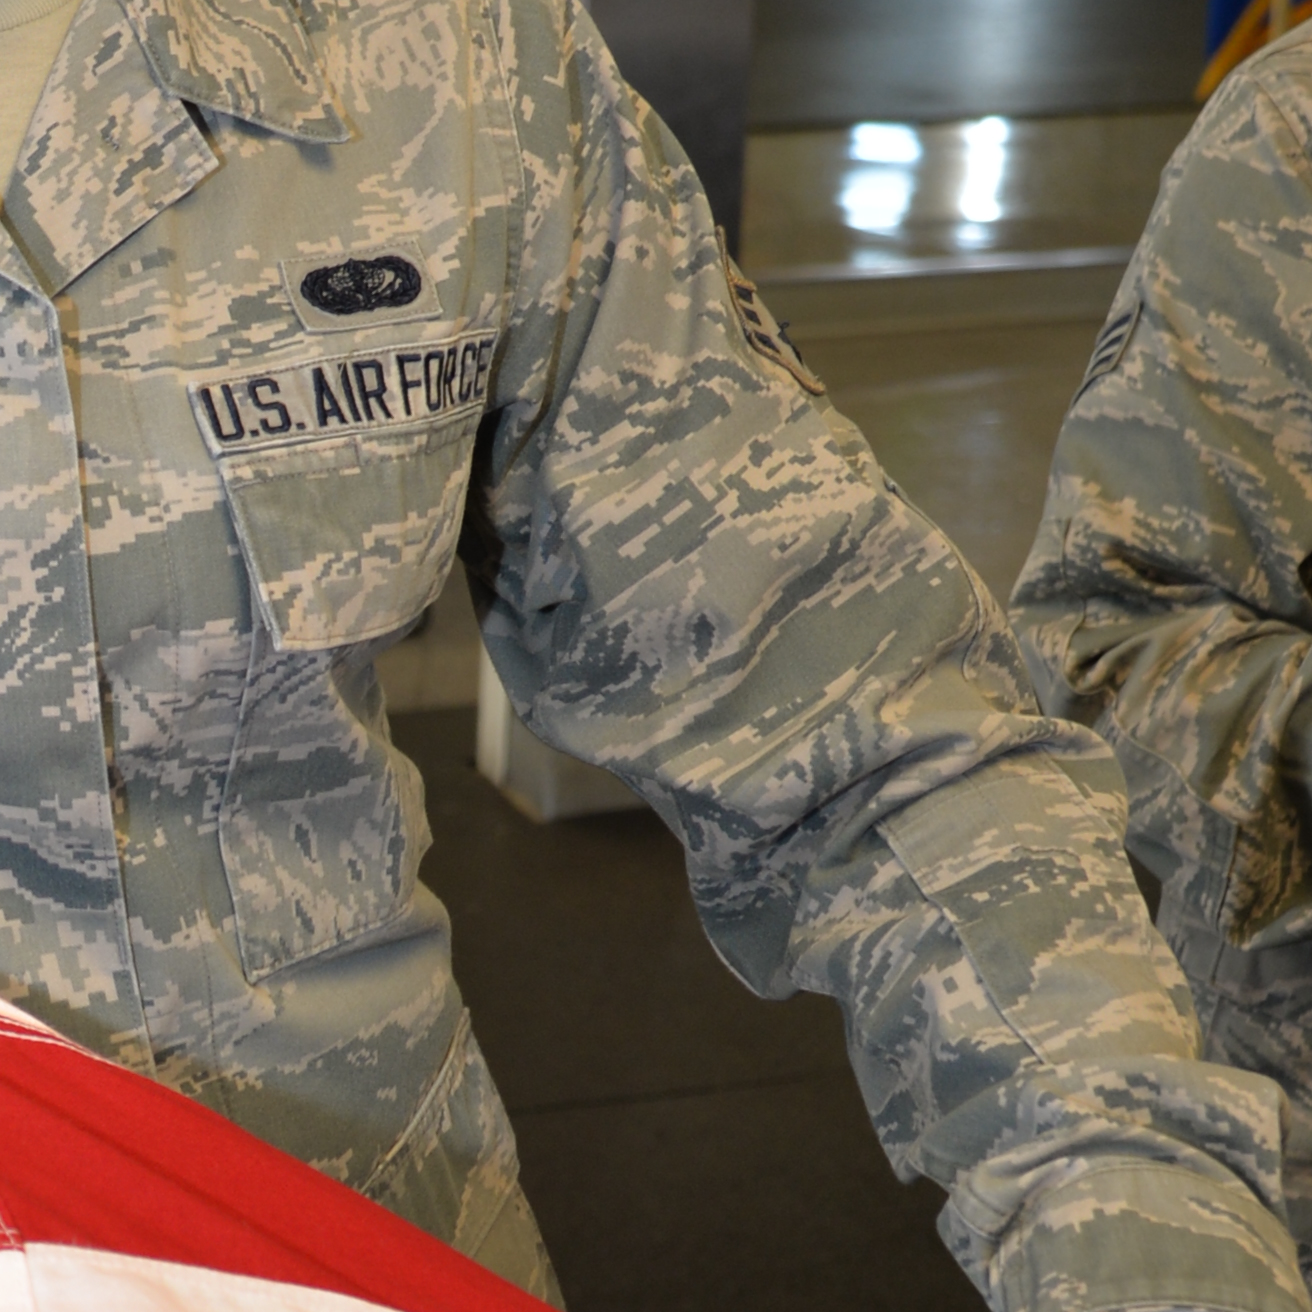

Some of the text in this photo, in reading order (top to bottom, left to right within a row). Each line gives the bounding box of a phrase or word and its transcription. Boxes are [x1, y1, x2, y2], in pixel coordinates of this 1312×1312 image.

[201, 341, 495, 442] U.S. AIR FORCE
